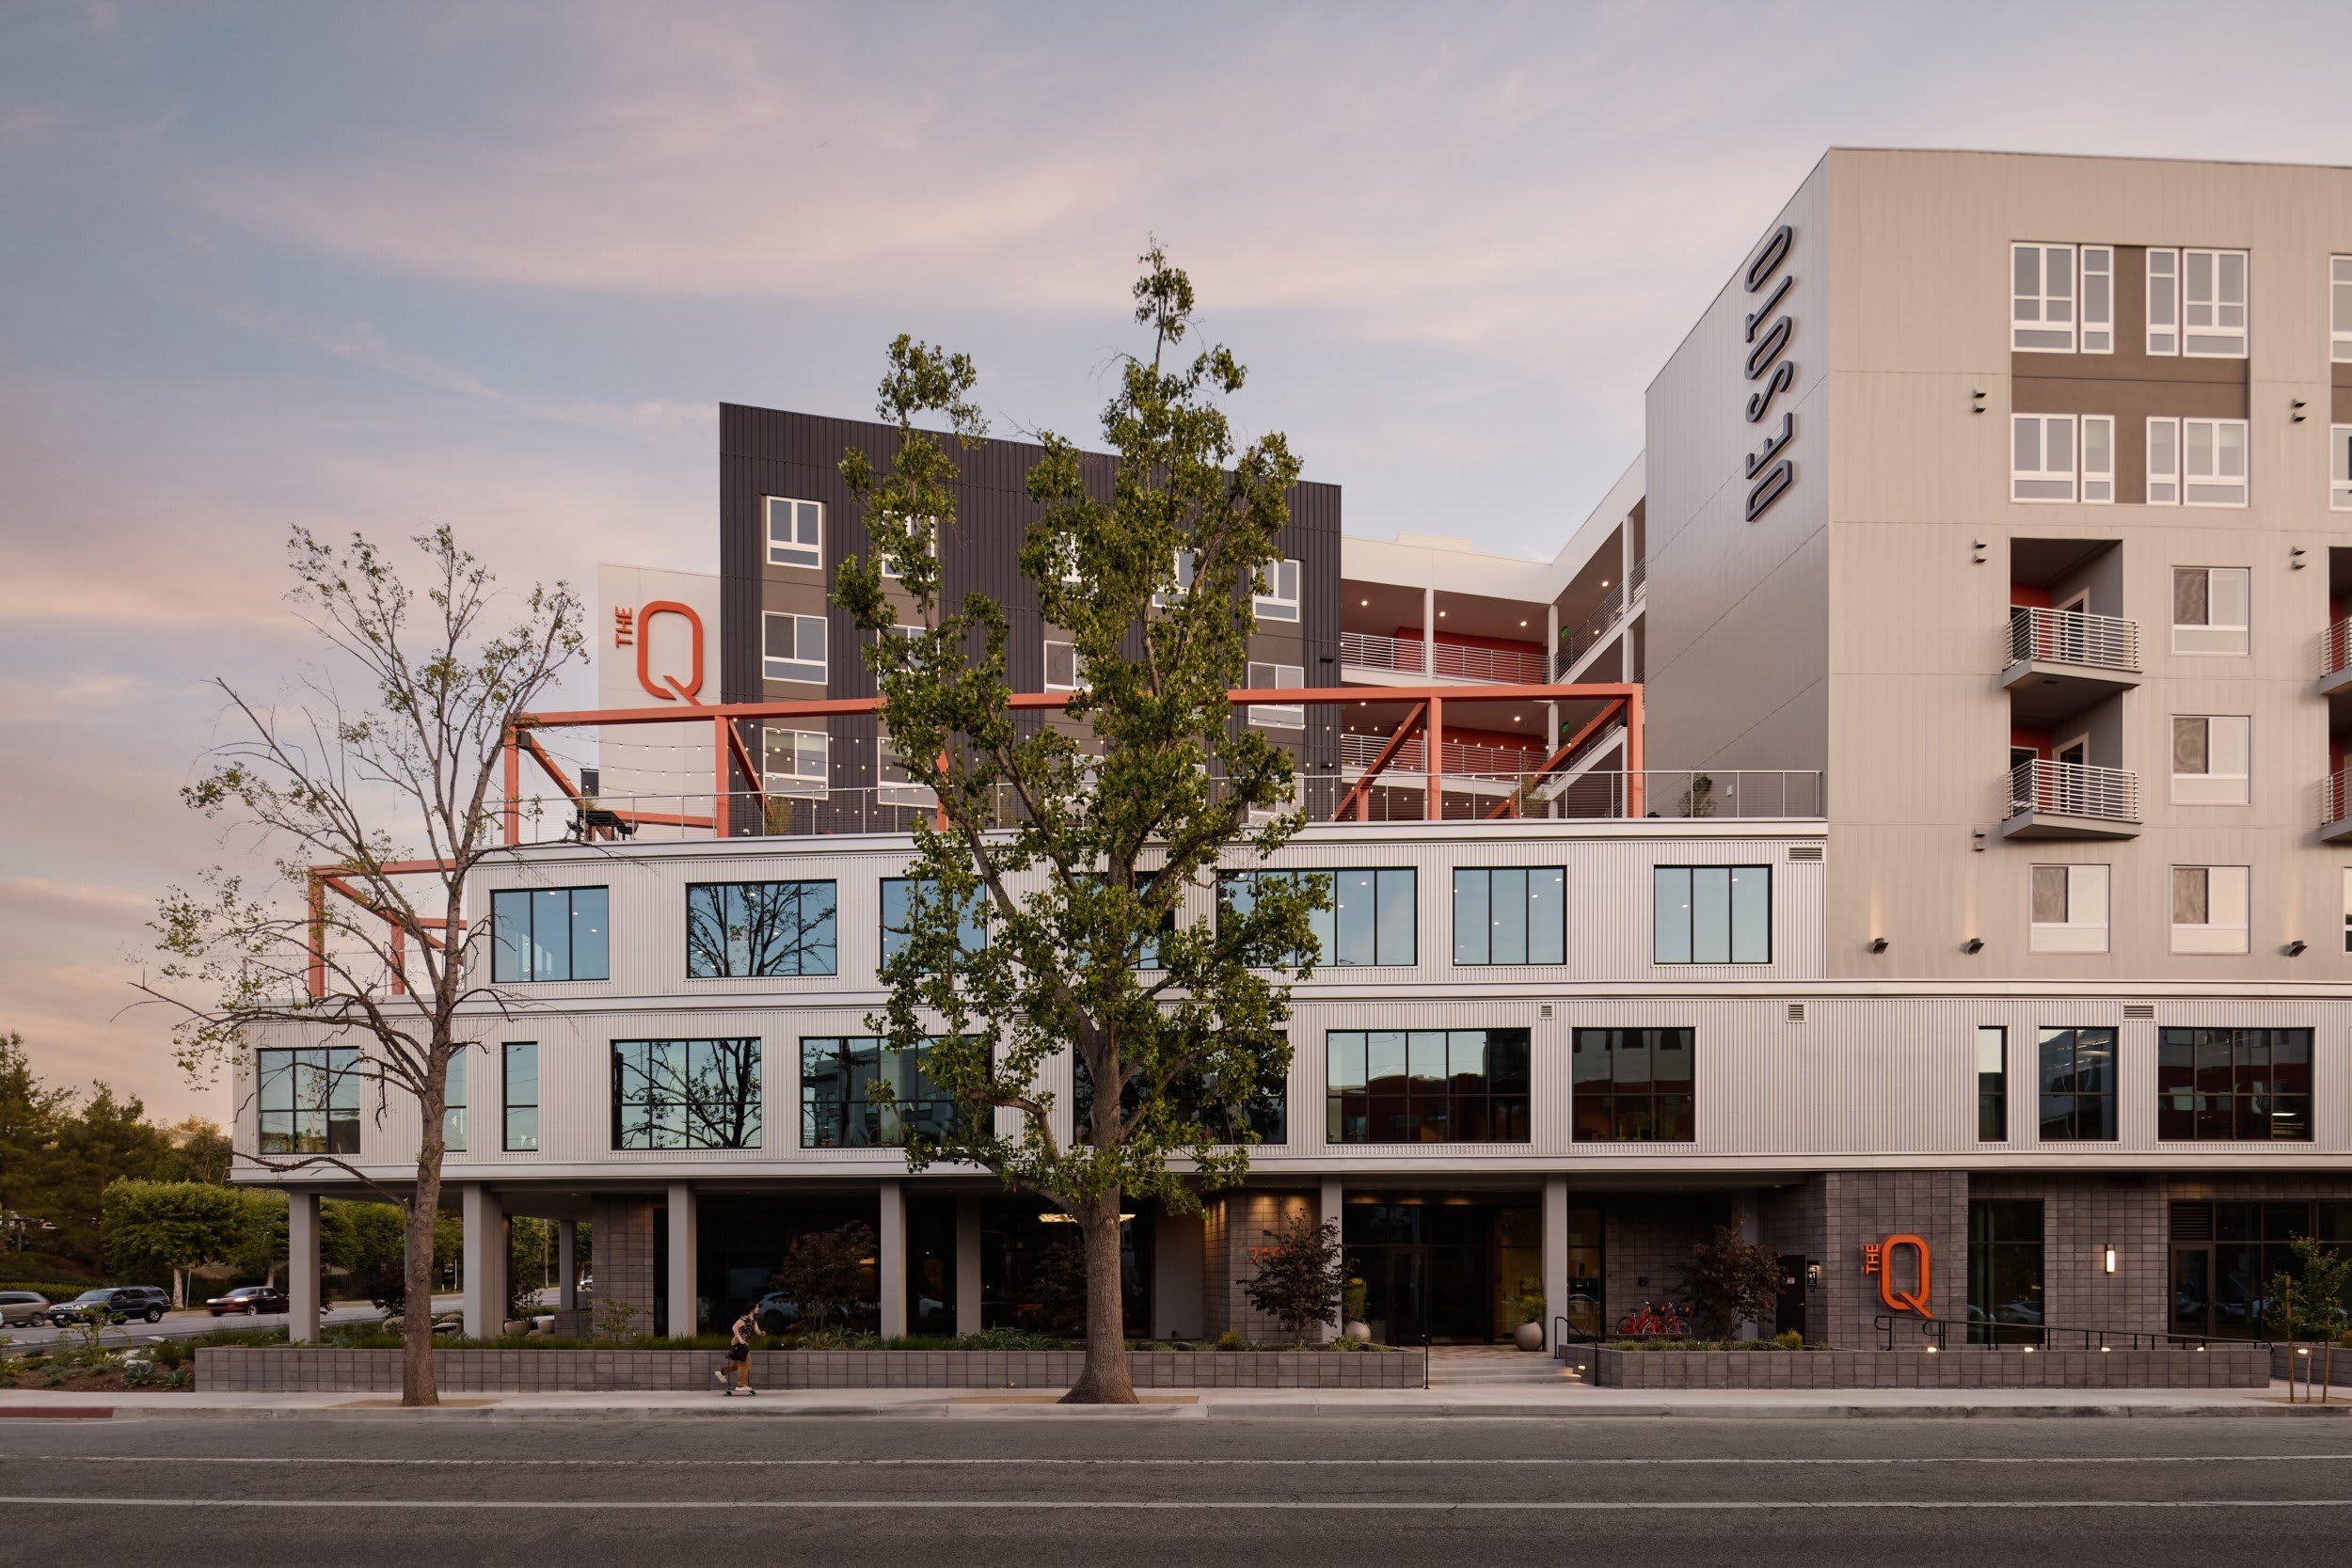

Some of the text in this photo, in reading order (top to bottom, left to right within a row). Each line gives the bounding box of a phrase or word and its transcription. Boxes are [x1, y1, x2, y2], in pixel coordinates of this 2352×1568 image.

[614, 600, 704, 706] THE Q
[1863, 1233, 1934, 1319] THE Q
